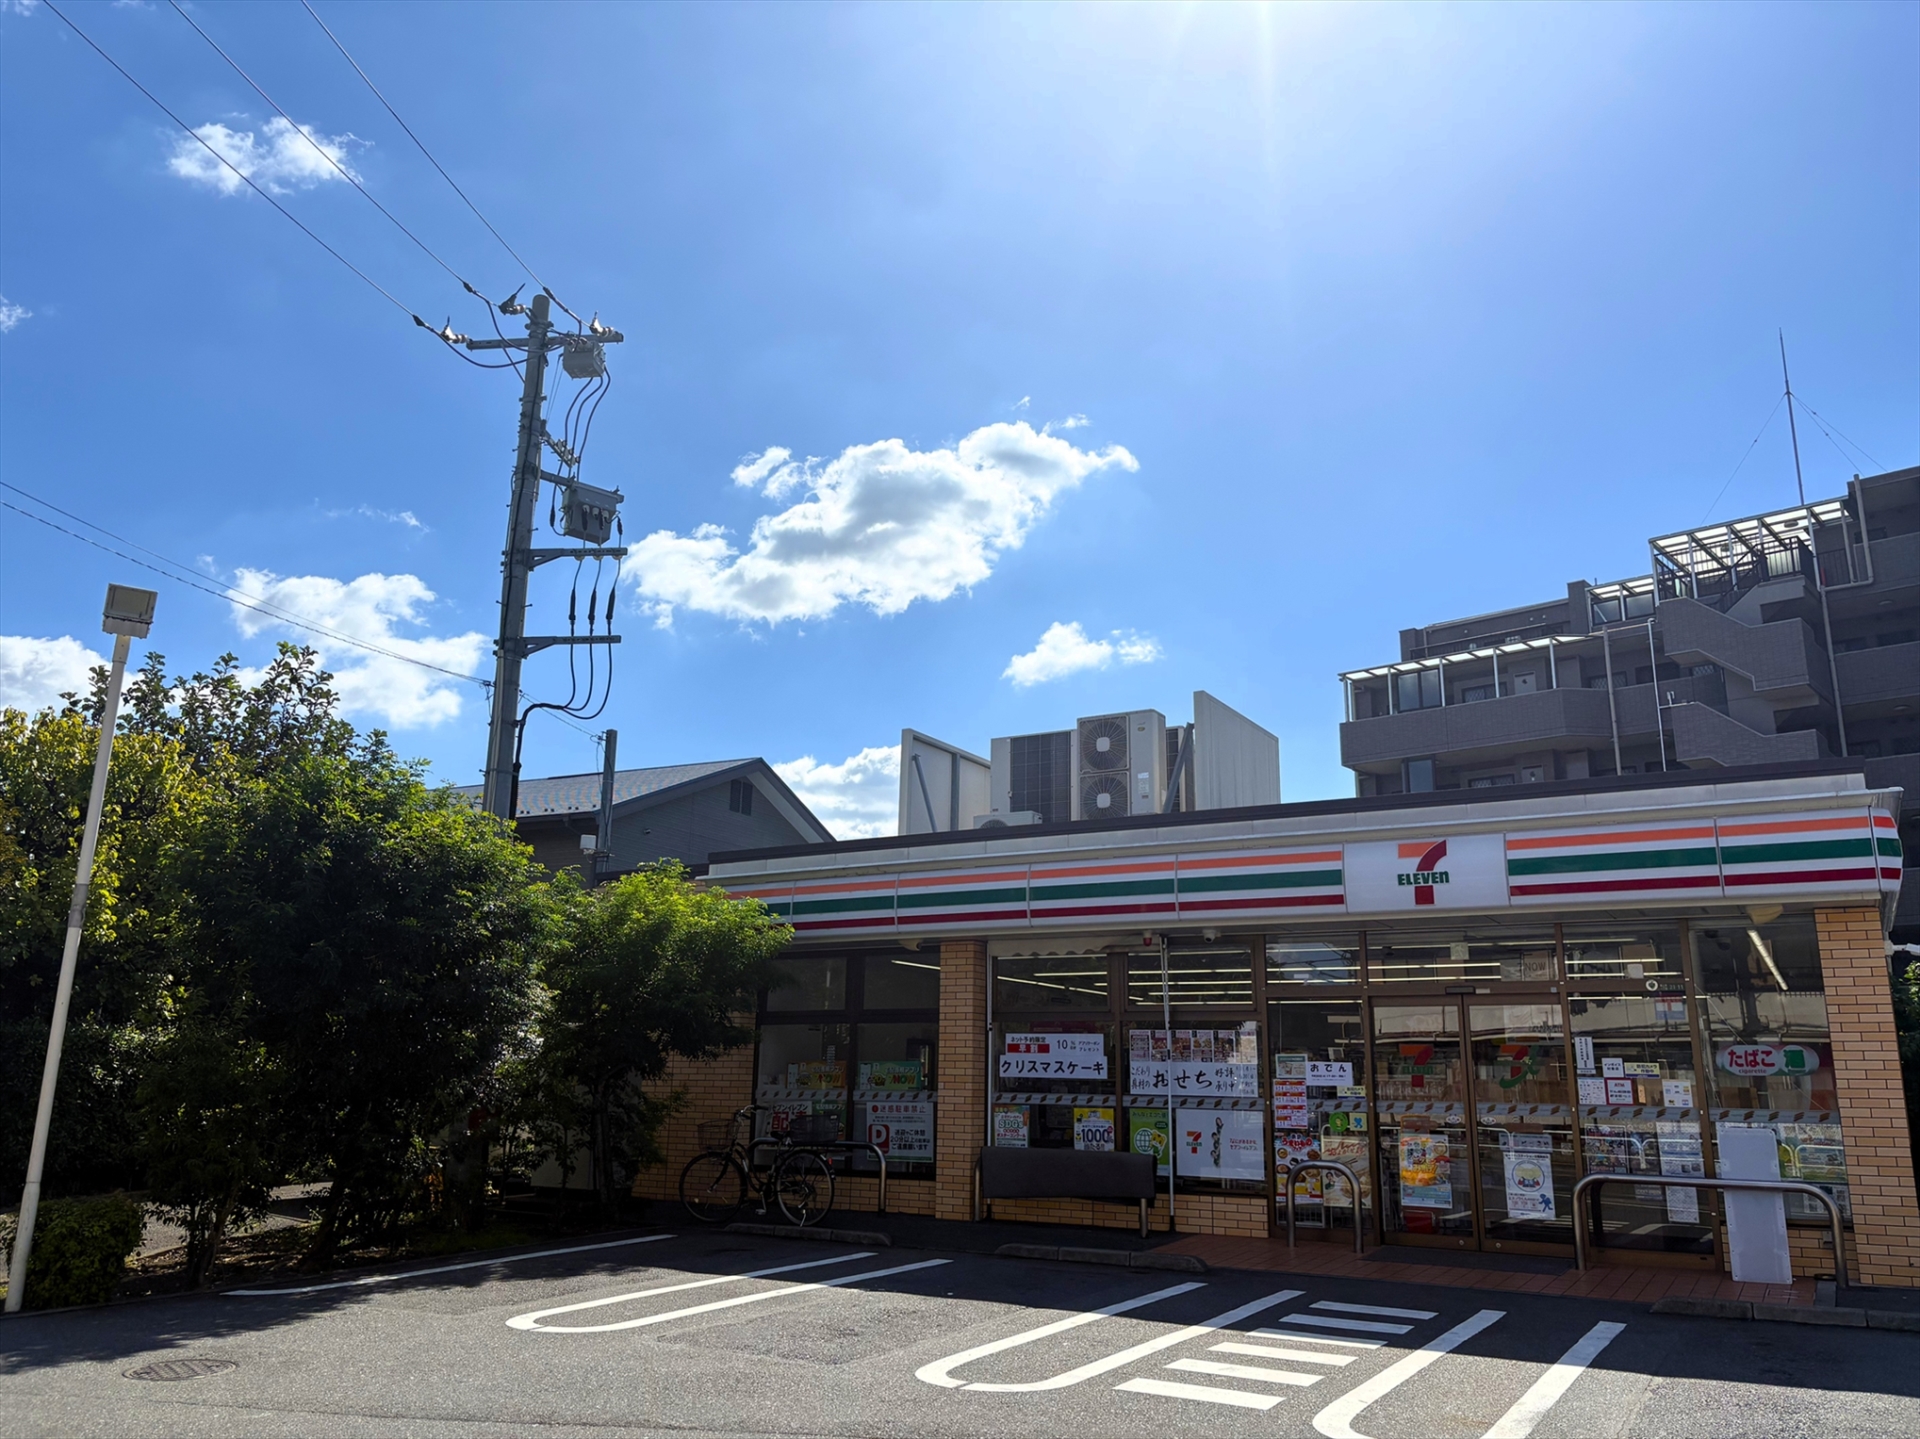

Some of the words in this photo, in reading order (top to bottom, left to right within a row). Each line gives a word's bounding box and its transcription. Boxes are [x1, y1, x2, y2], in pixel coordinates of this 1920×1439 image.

[1397, 839, 1447, 905] 7
[1728, 1048, 1775, 1068] たばこ
[1001, 1060, 1105, 1075] クリスマスケーキ
[1310, 1063, 1347, 1073] おでん
[1152, 1069, 1213, 1090] おせち
[998, 1119, 1024, 1129] SDGs
